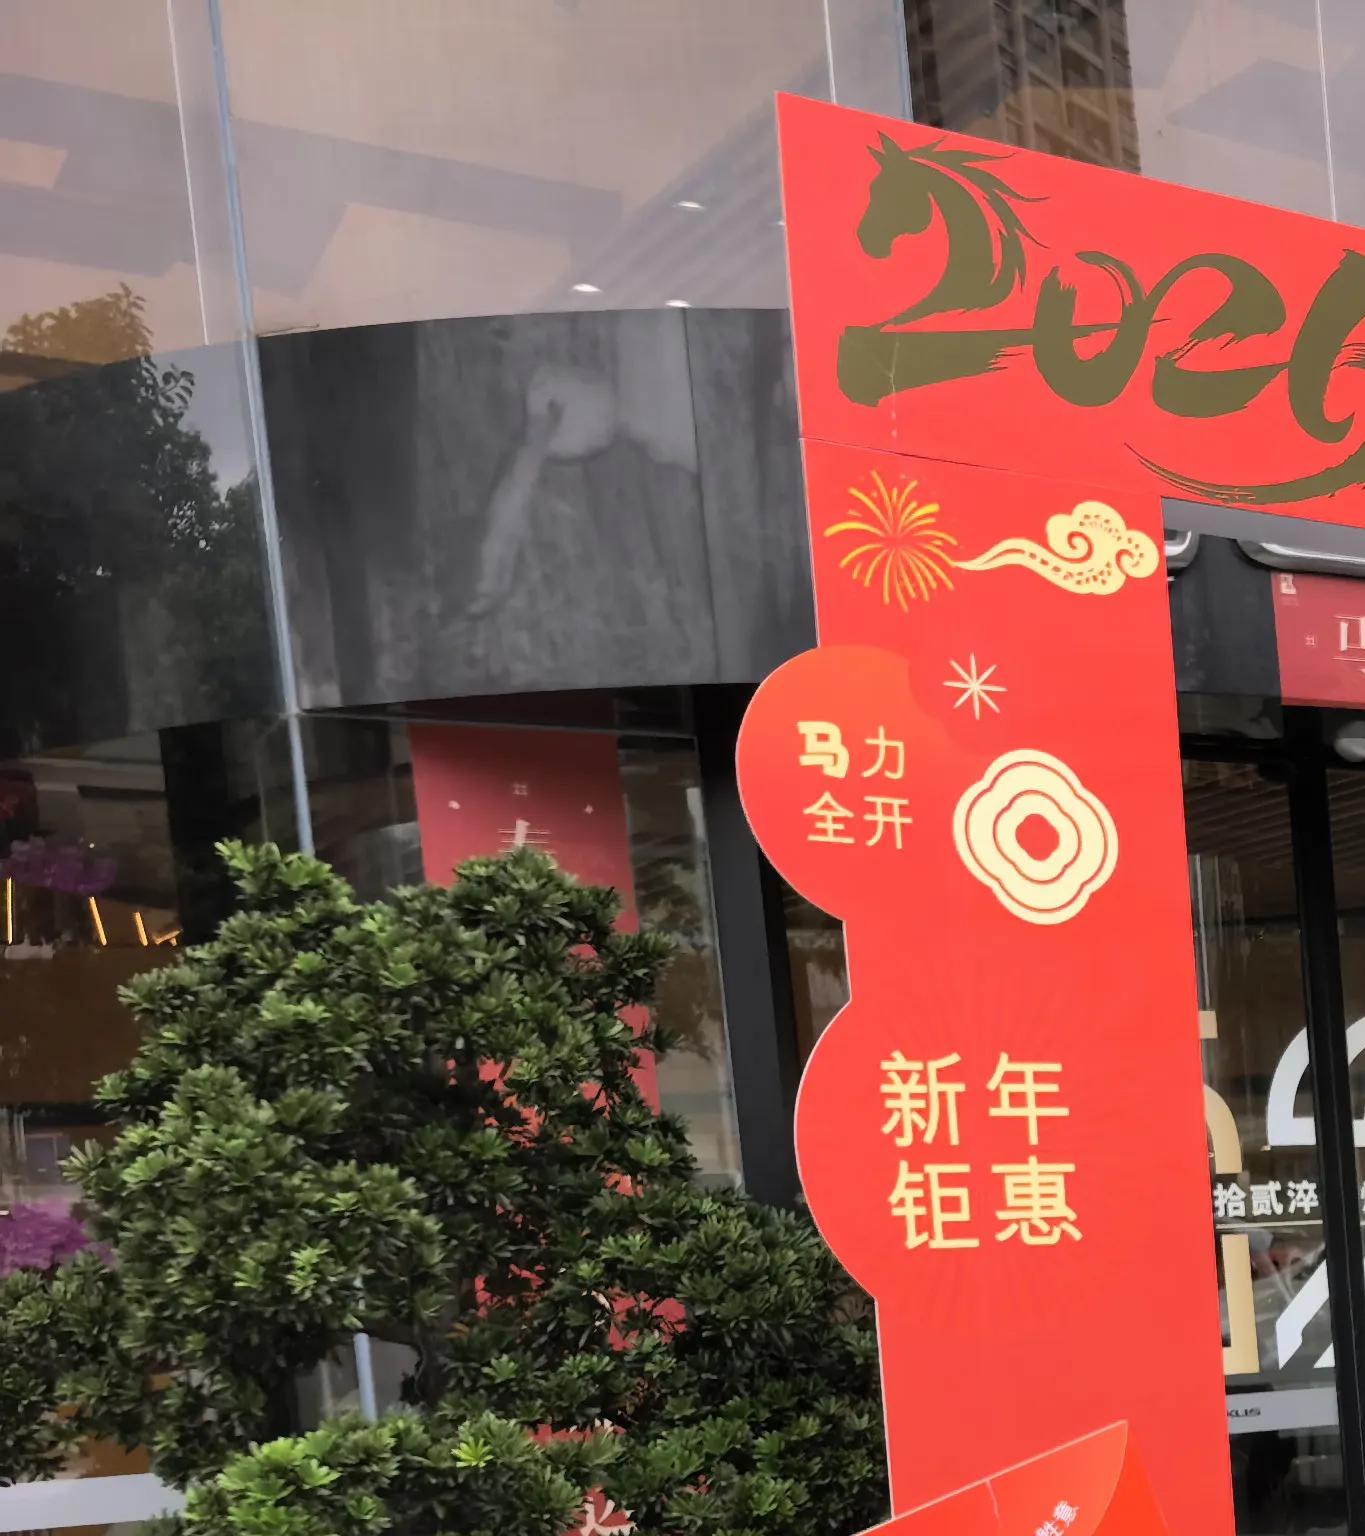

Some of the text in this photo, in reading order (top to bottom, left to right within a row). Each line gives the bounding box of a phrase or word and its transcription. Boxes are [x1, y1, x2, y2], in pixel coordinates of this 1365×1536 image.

[796, 720, 906, 780] 马力
[803, 791, 913, 850] 全开
[878, 1051, 1070, 1147] 新年
[888, 1155, 1083, 1251] 钜惠
